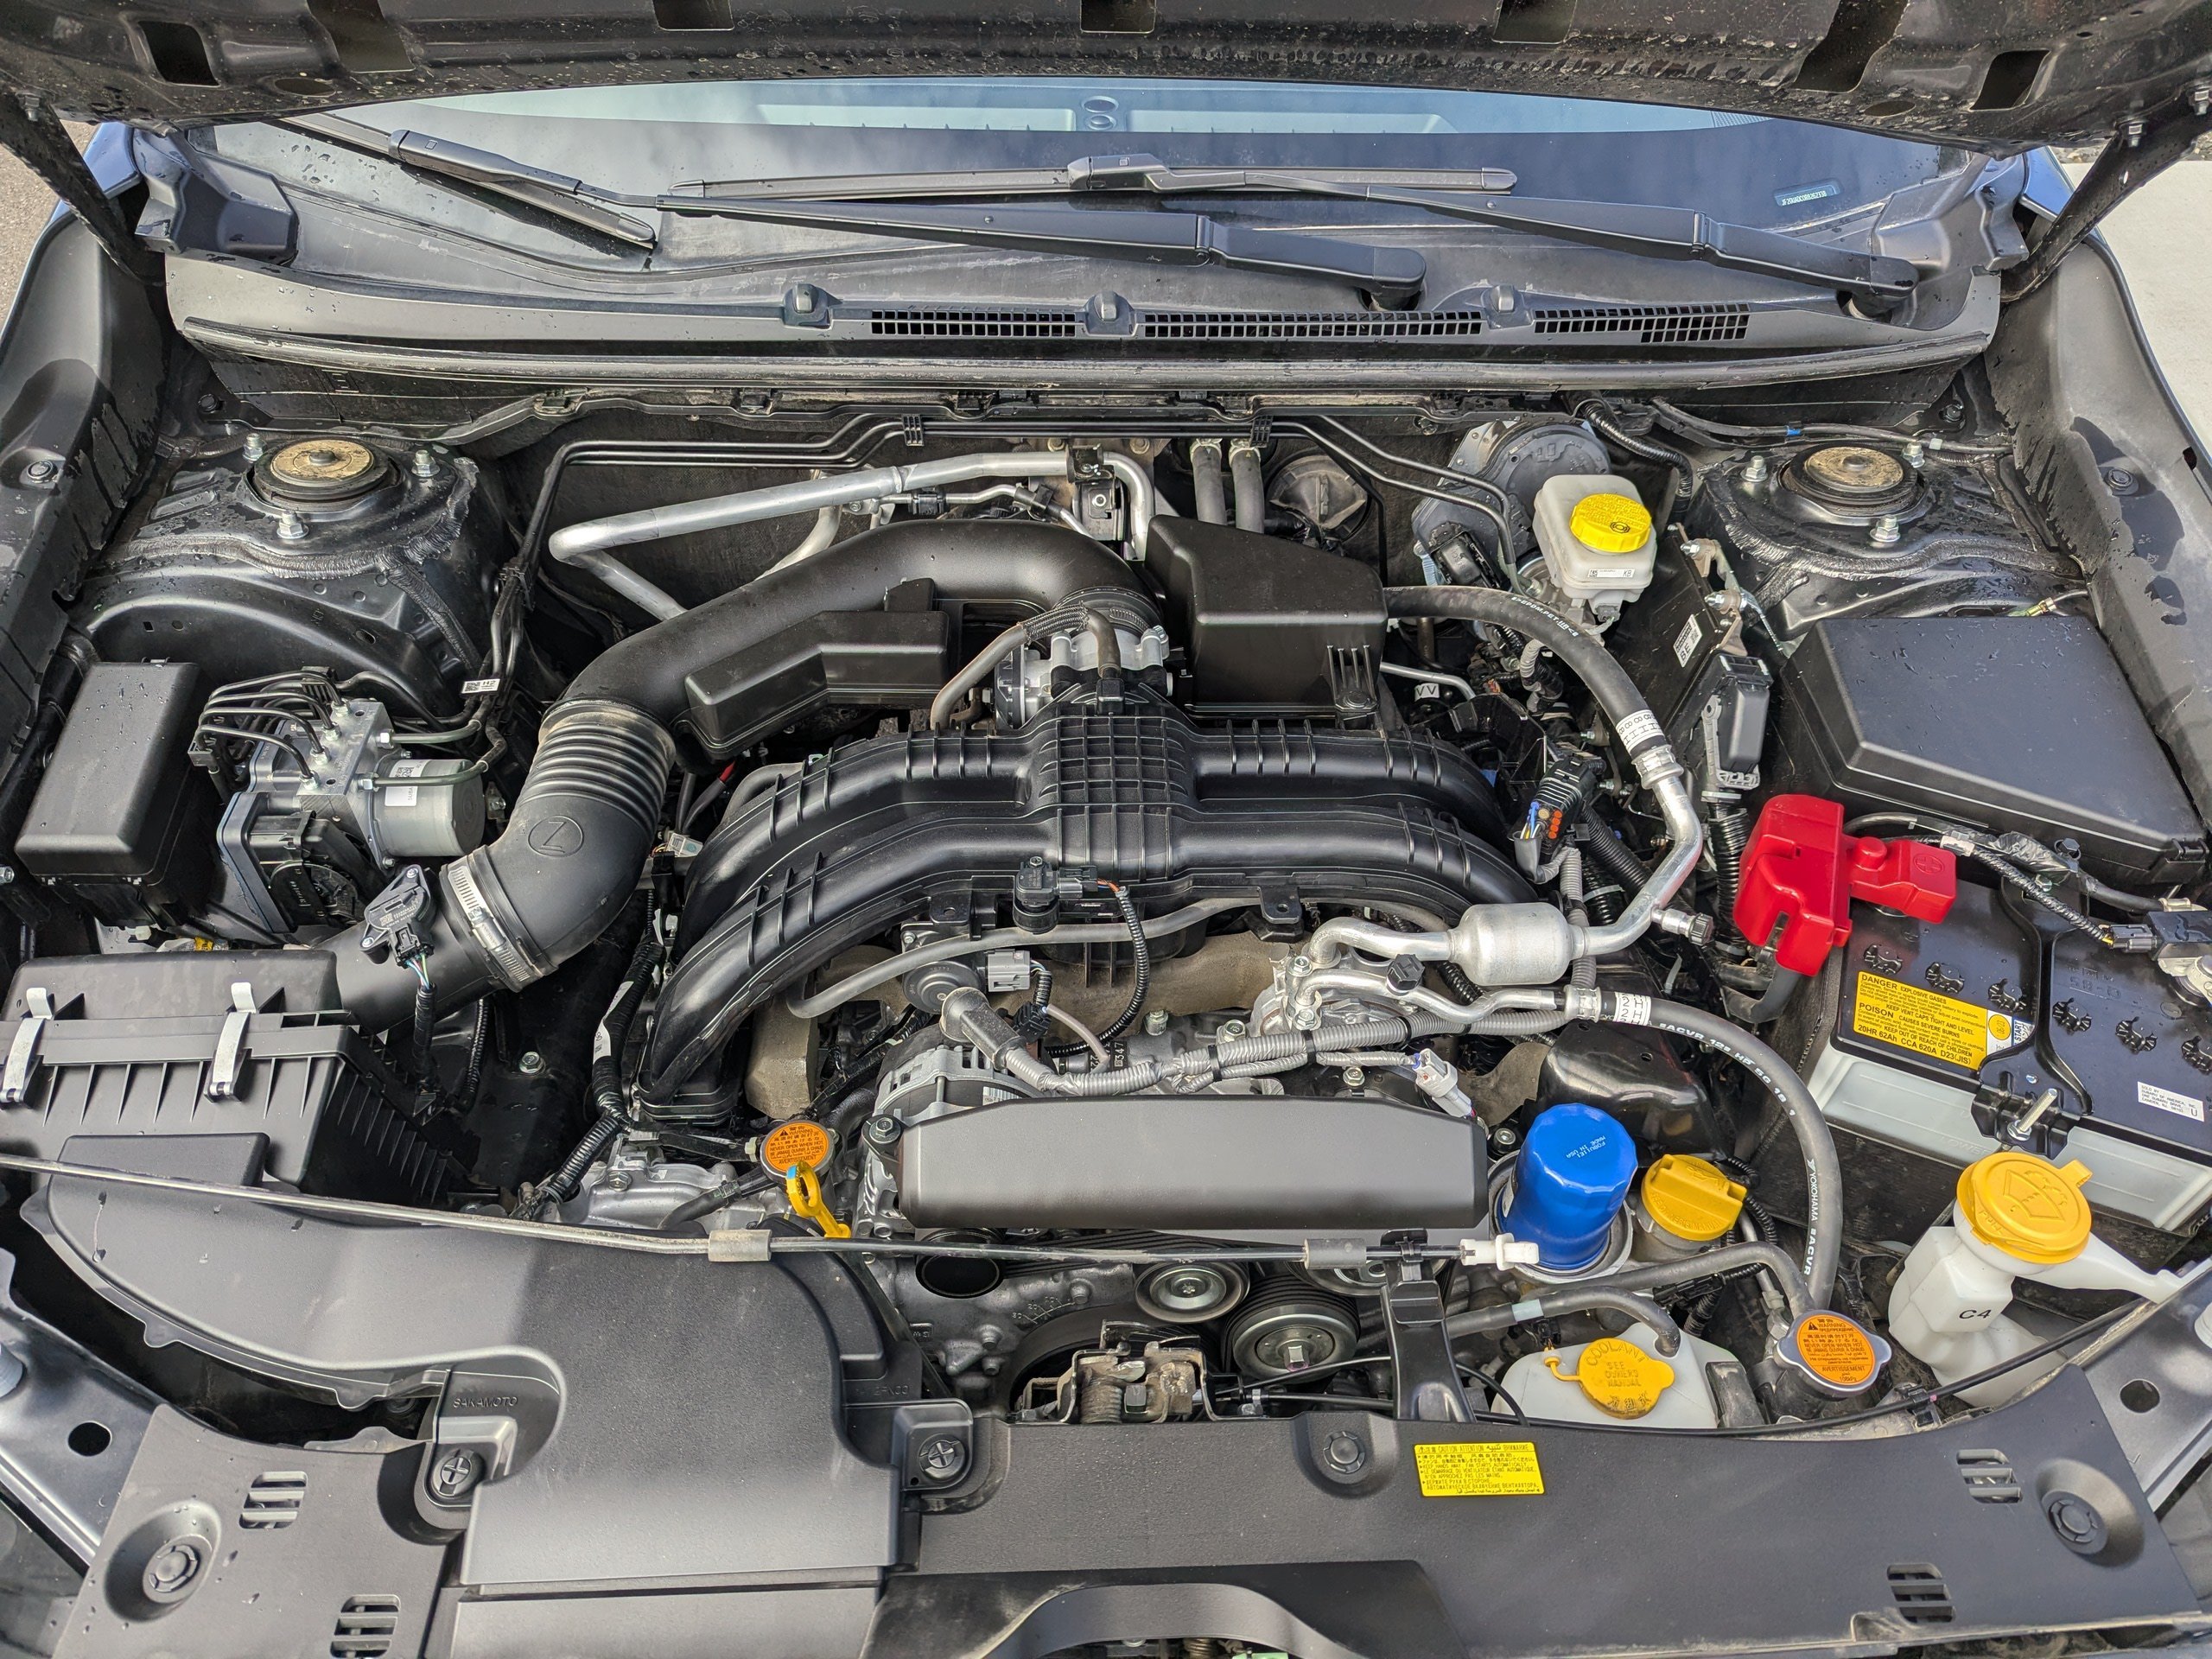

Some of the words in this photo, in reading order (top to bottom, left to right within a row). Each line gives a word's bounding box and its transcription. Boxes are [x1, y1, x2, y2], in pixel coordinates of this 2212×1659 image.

[1861, 973, 1897, 989] DANGER
[1900, 986, 1927, 998] EXPLOSIVE
[1929, 995, 1946, 1004] GASES
[1859, 1001, 1893, 1018] POISON
[1898, 1014, 1918, 1026] CAUSES
[1921, 1021, 1940, 1032] SEVERE
[1942, 1028, 1960, 1038] BURNS
[1885, 1003, 1899, 1012] KEEP
[1900, 1007, 1913, 1016] VENT
[1915, 1013, 1929, 1021] CAPS
[1930, 1017, 1944, 1026] TIGHT
[1858, 1024, 1877, 1036] 20HR
[1878, 1030, 1897, 1042] 62Ah
[1901, 1037, 1916, 1048] CCA
[1918, 1043, 1936, 1054] 620A
[1941, 1049, 1970, 1065] D23(JIS)
[1884, 1026, 1897, 1034] KEEP
[1919, 1036, 1936, 1046] REACH
[1946, 1045, 1972, 1057] CHILDREN
[2191, 1108, 2197, 1116] U
[1590, 1135, 1605, 1146] MADE
[1809, 1173, 1818, 1221] YOKOHAMA
[1979, 1210, 2003, 1236] PULL
[1959, 1310, 1992, 1319] C4
[1586, 1340, 1645, 1366] COOLANT
[1606, 1361, 1624, 1370] SEE
[1608, 1378, 1642, 1387] MANUAL
[453, 1396, 517, 1408] SAKAMOTO
